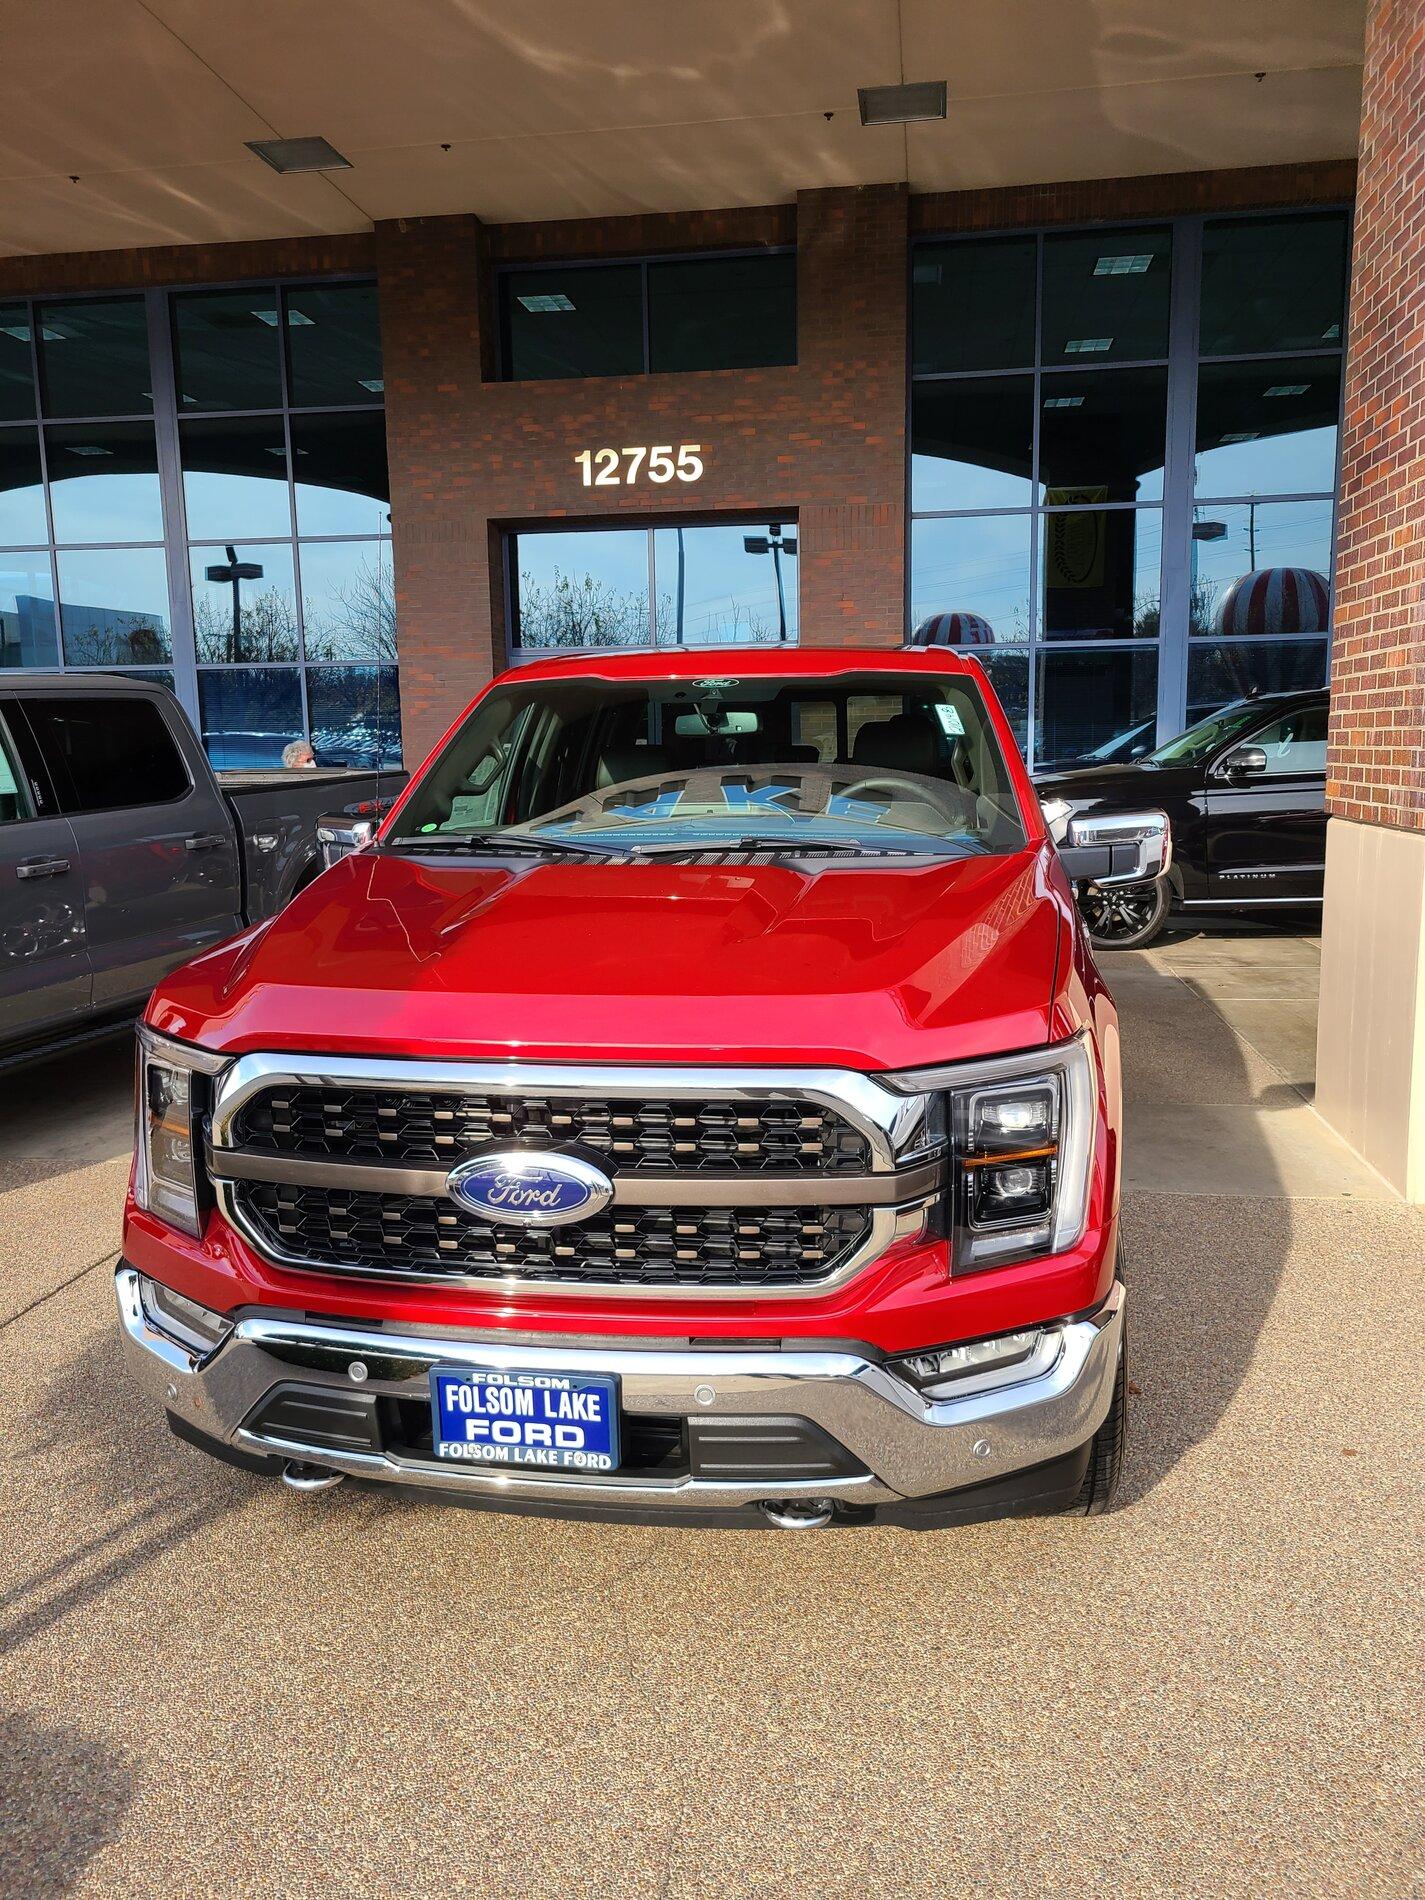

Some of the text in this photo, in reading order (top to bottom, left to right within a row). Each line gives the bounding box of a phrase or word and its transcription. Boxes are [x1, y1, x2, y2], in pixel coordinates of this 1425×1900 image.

[574, 444, 704, 487] 12755
[1219, 872, 1276, 880] PLATINUM
[487, 1171, 562, 1207] Ford
[472, 1372, 571, 1390] FOLSOM
[445, 1384, 602, 1422] FOLSOM LAKE
[465, 1418, 586, 1449] FORD
[439, 1443, 612, 1470] FOLSOM LAKE FORD
